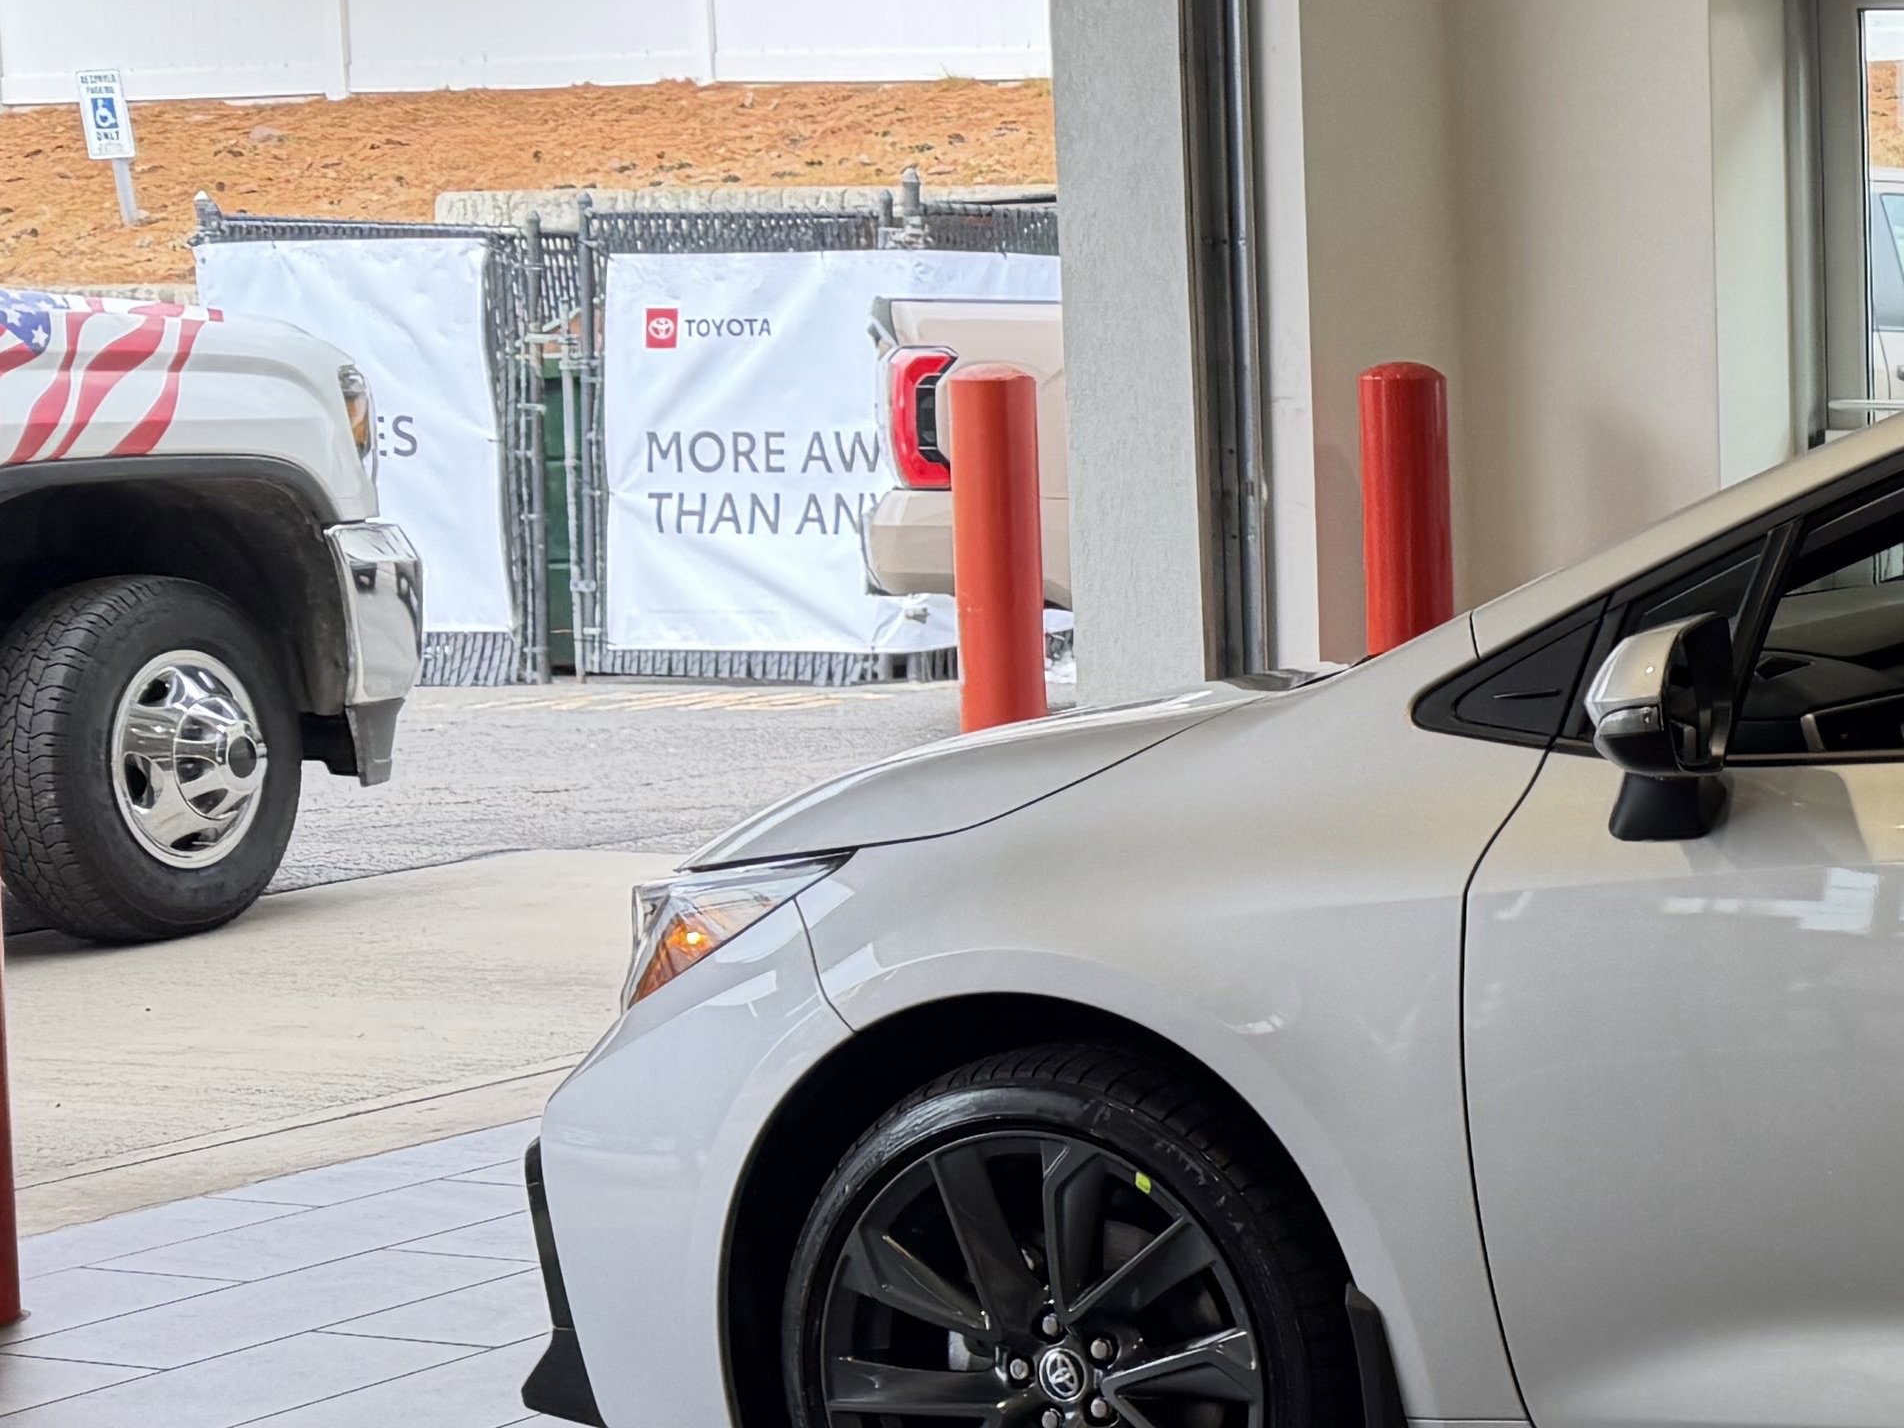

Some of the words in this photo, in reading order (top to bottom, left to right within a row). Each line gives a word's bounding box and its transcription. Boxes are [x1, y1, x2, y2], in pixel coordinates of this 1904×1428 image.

[684, 318, 771, 337] TOYOTA
[646, 430, 786, 473] MORE
[647, 492, 780, 535] THAN
